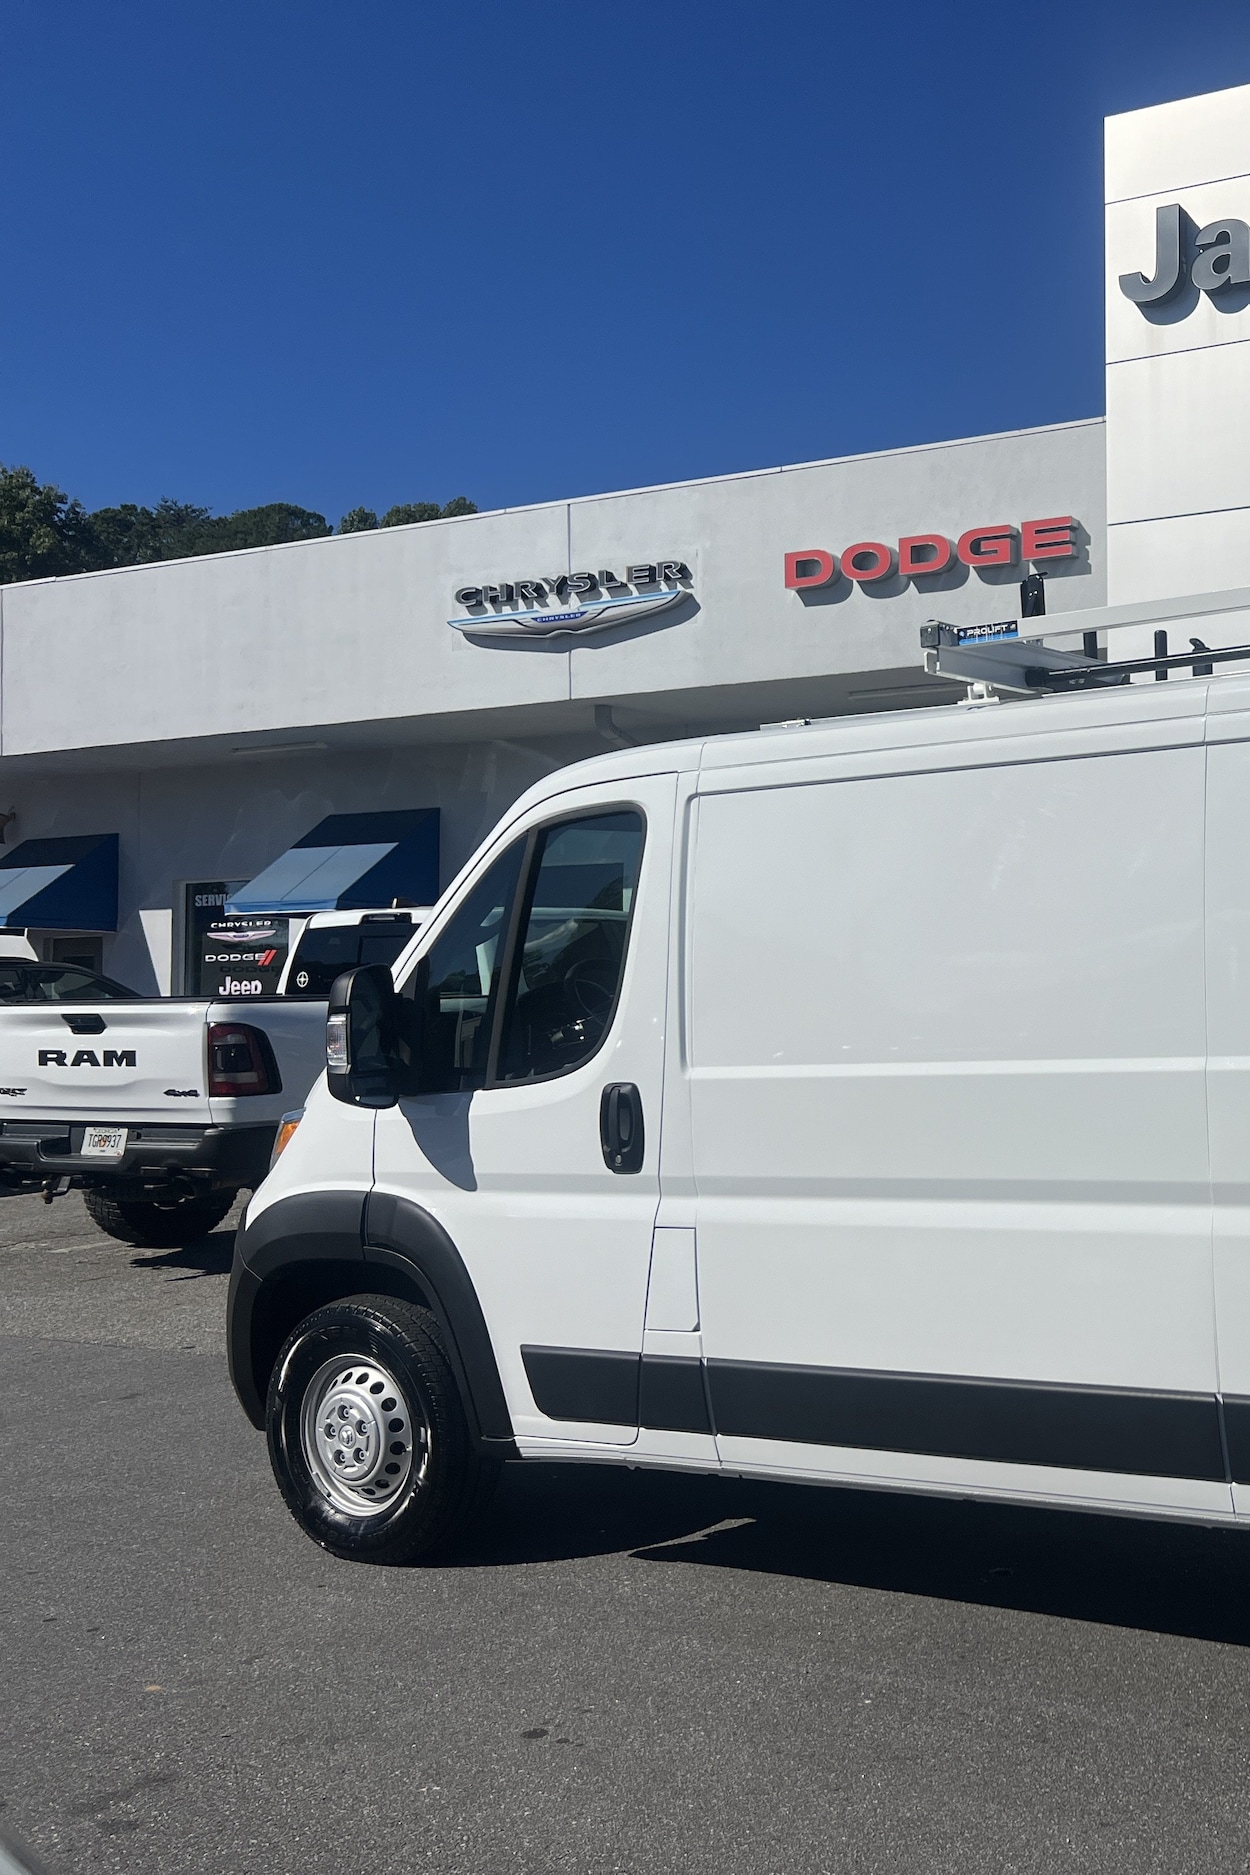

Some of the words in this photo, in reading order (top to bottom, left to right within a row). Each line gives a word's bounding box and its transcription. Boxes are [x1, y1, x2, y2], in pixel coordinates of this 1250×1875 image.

[785, 516, 1075, 589] DODGE
[454, 561, 690, 606] CHRYSLER
[536, 611, 582, 623] CHRYSLER
[966, 624, 1008, 637] PROLIFT
[210, 920, 272, 929] CHRYSLER
[204, 953, 267, 963] DODGE
[218, 976, 262, 995] Jeep
[38, 1049, 137, 1067] RAM
